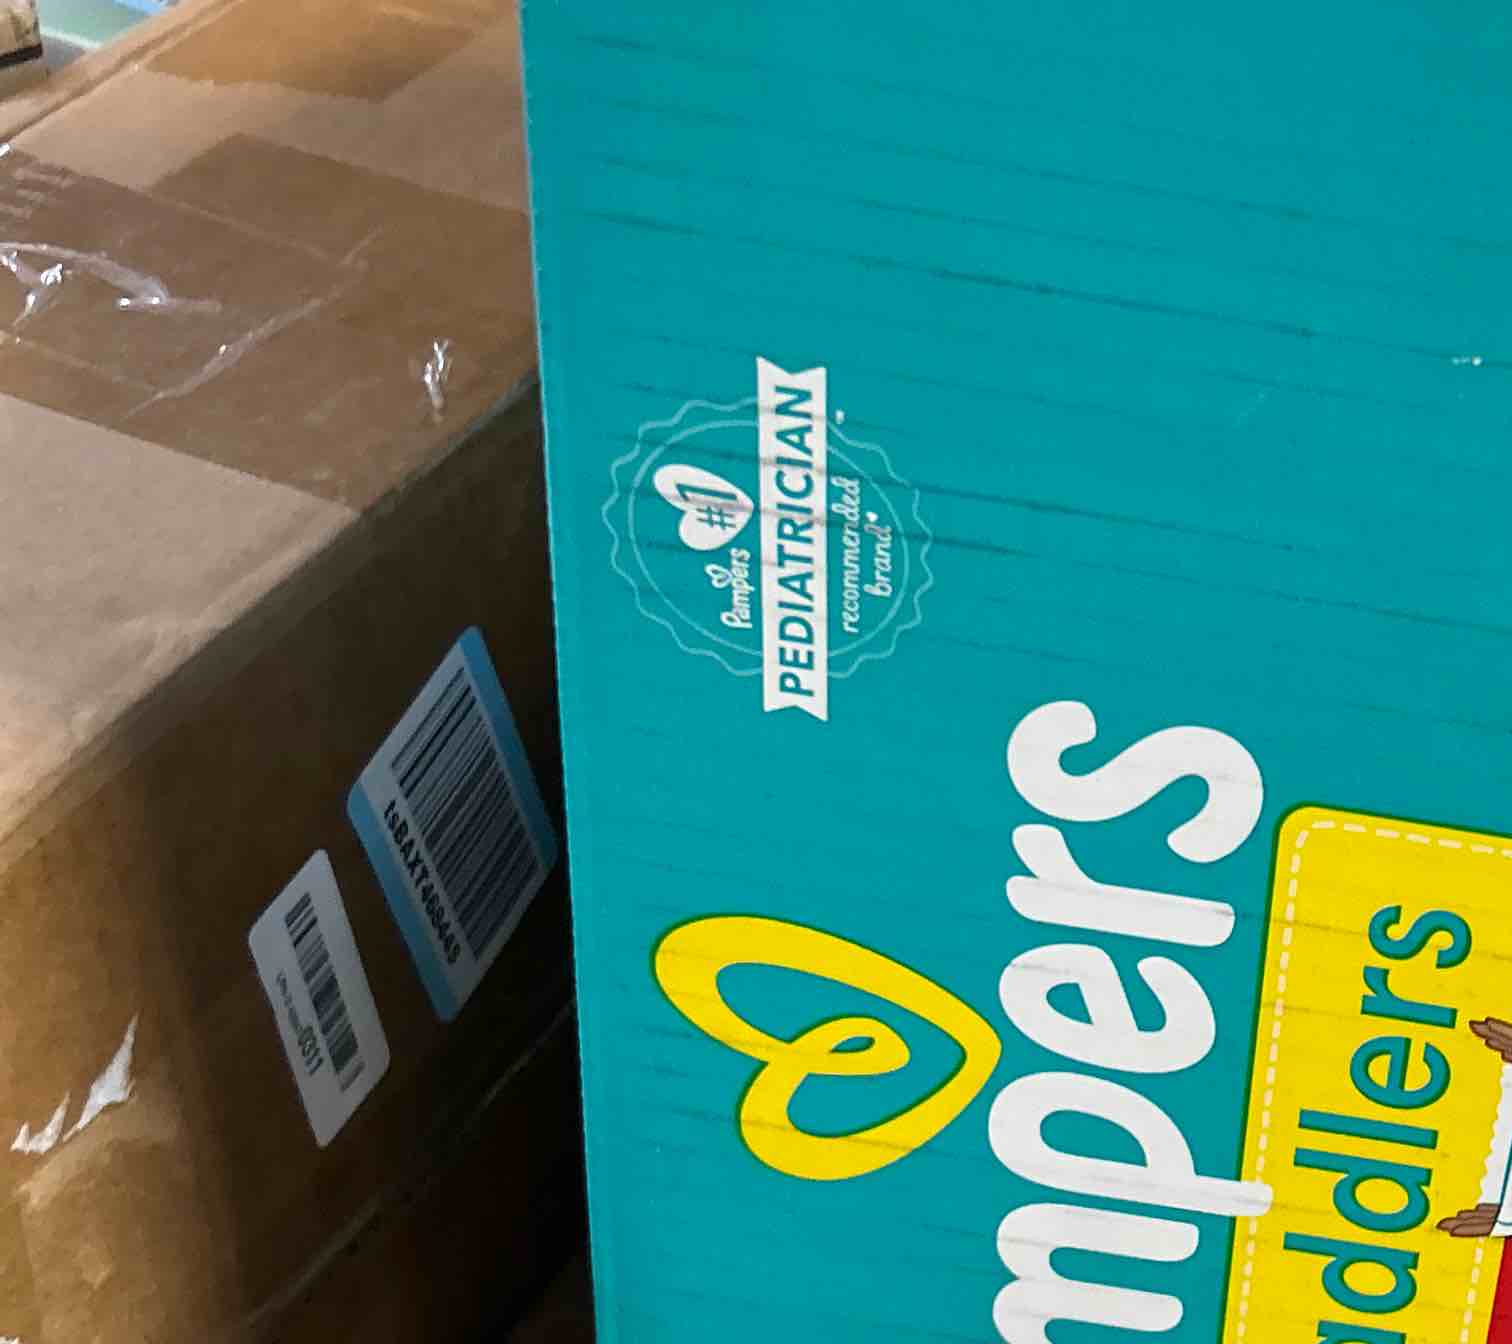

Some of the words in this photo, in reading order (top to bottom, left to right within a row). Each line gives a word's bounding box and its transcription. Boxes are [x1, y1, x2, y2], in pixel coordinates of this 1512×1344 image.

[676, 480, 738, 529] #1
[774, 384, 815, 697] PEDIATRICIAN
[832, 475, 862, 632] recommended
[720, 547, 755, 628] Pampers
